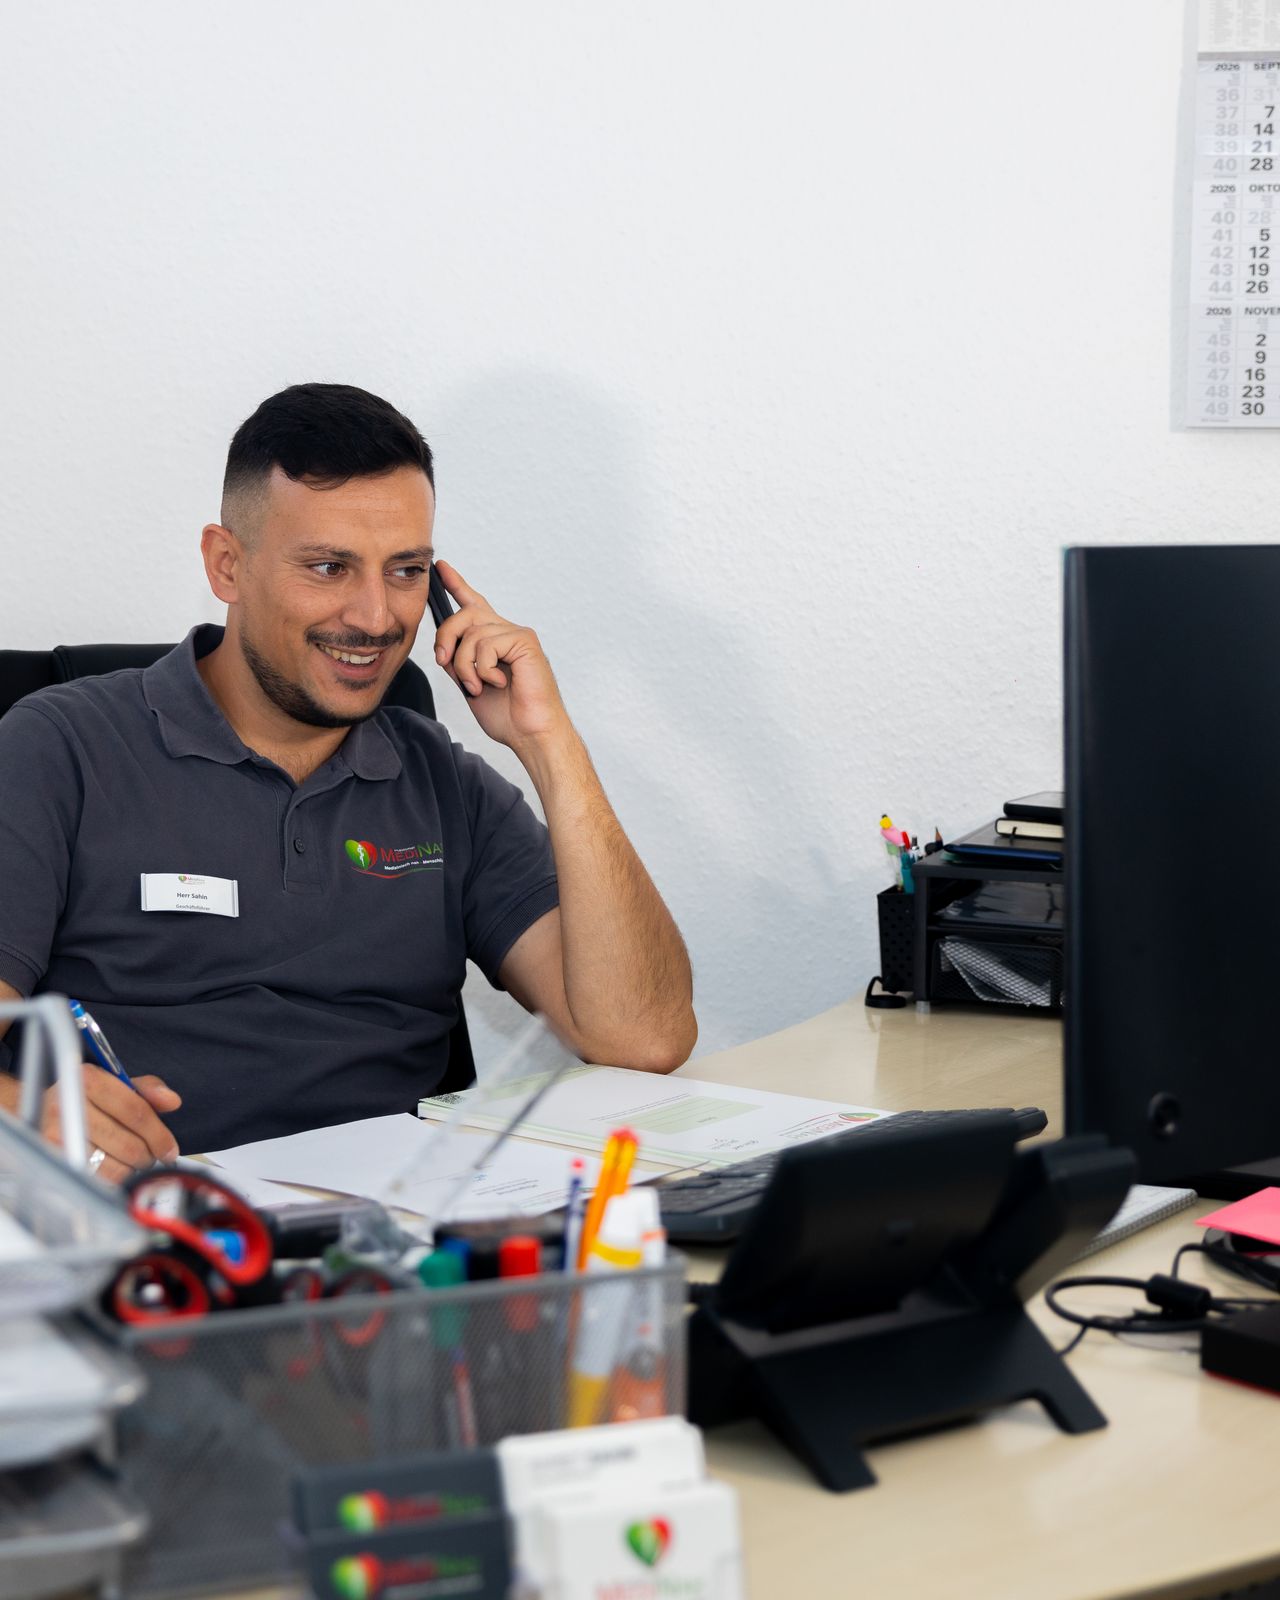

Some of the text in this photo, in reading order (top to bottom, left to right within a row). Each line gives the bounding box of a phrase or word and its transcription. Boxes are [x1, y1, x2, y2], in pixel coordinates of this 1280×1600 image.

[1215, 63, 1240, 71] 2026
[1216, 88, 1274, 102] 36 31
[1216, 105, 1275, 119] 37 7
[1215, 123, 1274, 136] 38 14
[1214, 140, 1272, 153] 39 21
[1213, 158, 1273, 171] 40 28
[1210, 185, 1236, 193] 2026
[1211, 211, 1271, 225] 40 28
[1212, 228, 1270, 242] 41 5
[1210, 246, 1270, 259] 42 12
[1209, 263, 1269, 276] 43 19
[1208, 280, 1269, 294] 44 26
[1206, 307, 1232, 316] 2026
[1207, 333, 1266, 346] 45 2
[1206, 351, 1266, 364] 46 9
[1207, 368, 1265, 381] 47 16
[1205, 385, 1265, 398] 48 23
[1205, 402, 1264, 415] 49 30
